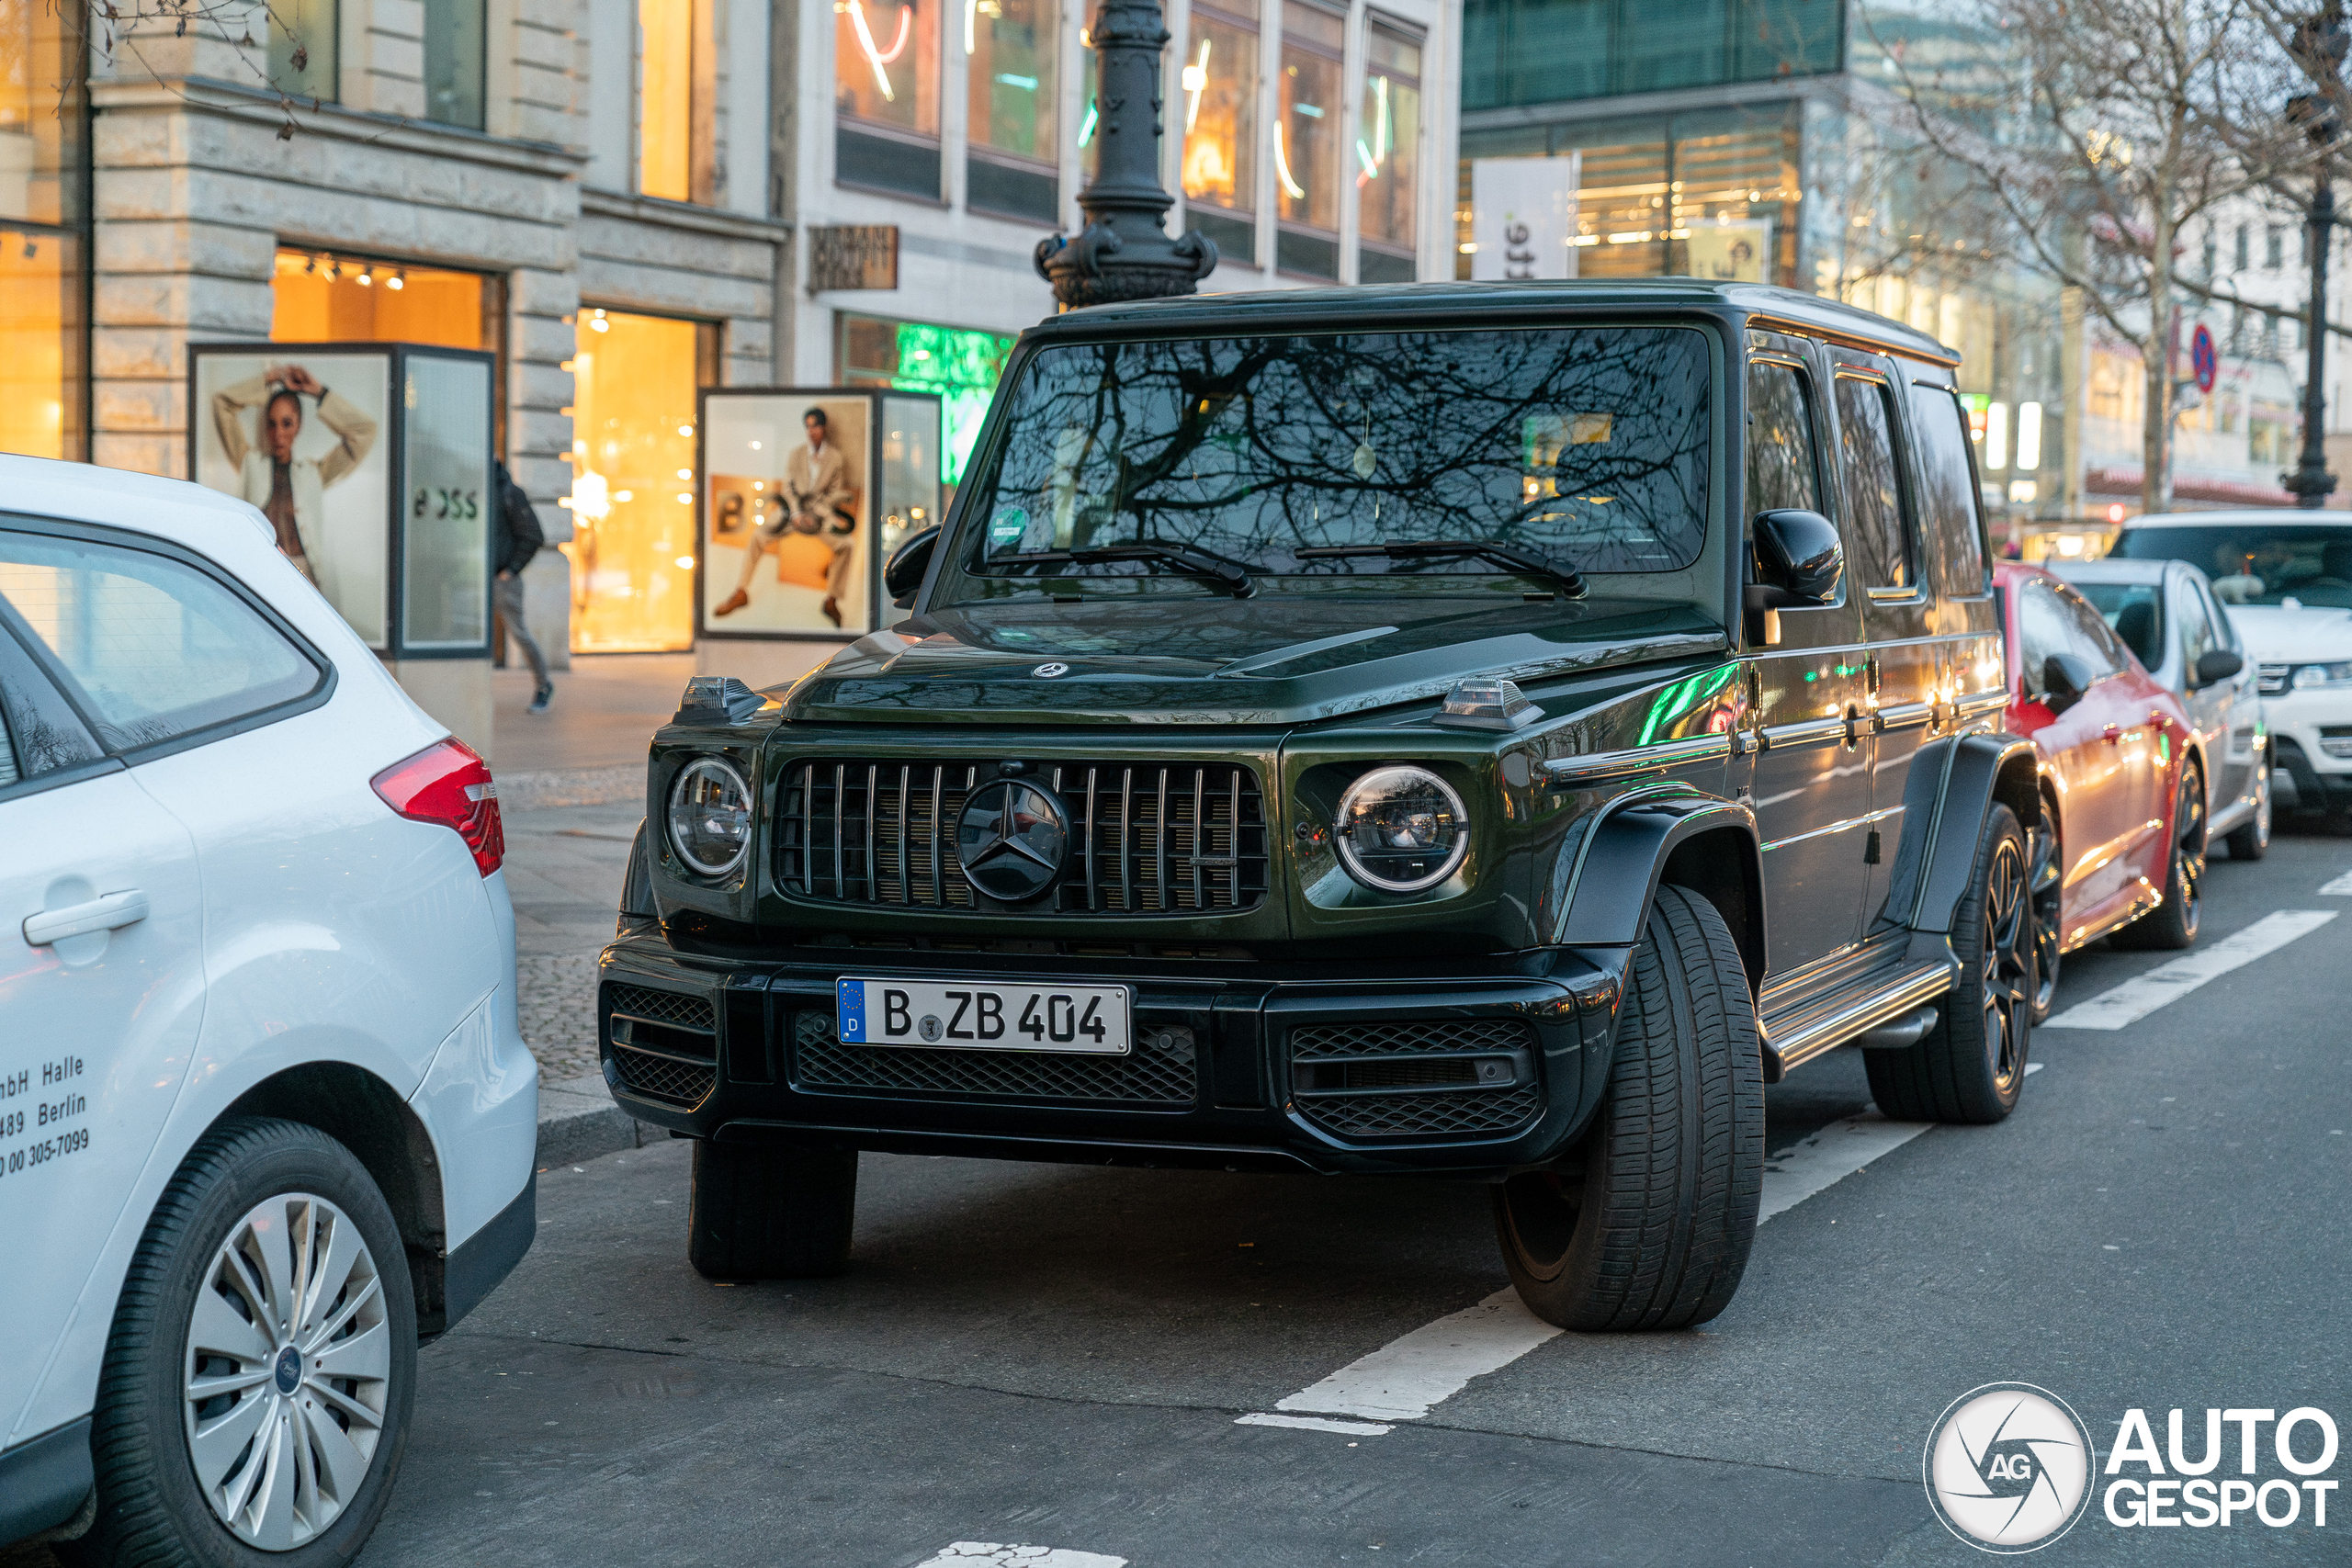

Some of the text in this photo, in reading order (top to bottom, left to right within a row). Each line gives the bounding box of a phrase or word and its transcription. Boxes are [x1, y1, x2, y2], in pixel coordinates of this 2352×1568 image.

[848, 1018, 858, 1032] D
[884, 988, 912, 1036] B
[945, 990, 1006, 1040] ZB
[1018, 993, 1106, 1043] 404
[42, 1055, 83, 1087] Halle
[38, 1092, 85, 1127] Berlin
[28, 1127, 89, 1168] 305-7099
